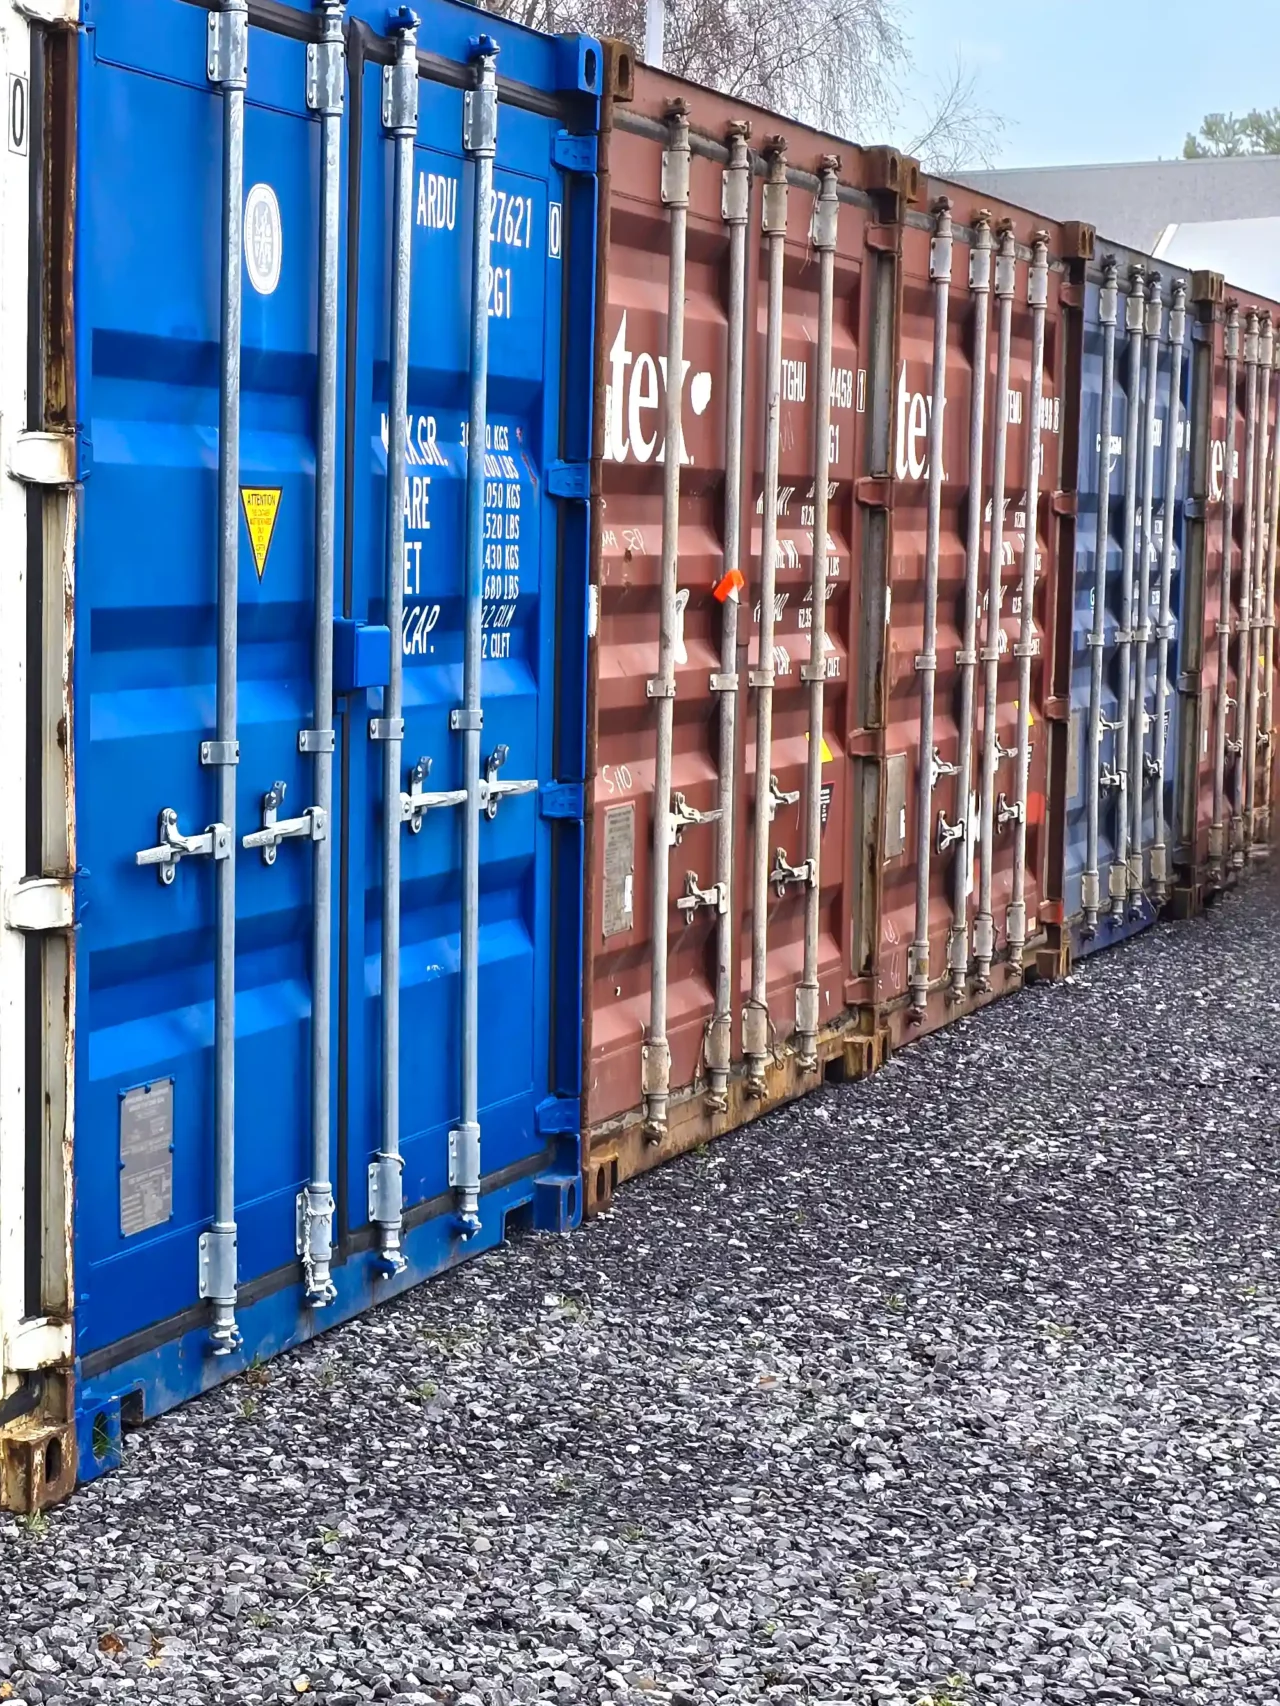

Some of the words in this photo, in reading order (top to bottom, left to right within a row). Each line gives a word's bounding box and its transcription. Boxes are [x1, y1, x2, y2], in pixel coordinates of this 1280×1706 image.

[11, 75, 26, 152] 0
[417, 171, 457, 231] ARDU
[550, 204, 561, 257] 0
[782, 358, 807, 403] TGHU
[381, 412, 449, 466] MX.GR.
[494, 424, 509, 451] KGS
[498, 454, 520, 479] LBS
[403, 476, 431, 529] ARE
[506, 483, 521, 509] KGS
[505, 513, 520, 540] LBS
[404, 541, 422, 595] ET
[505, 544, 519, 571] KGS
[503, 575, 519, 600] LBS
